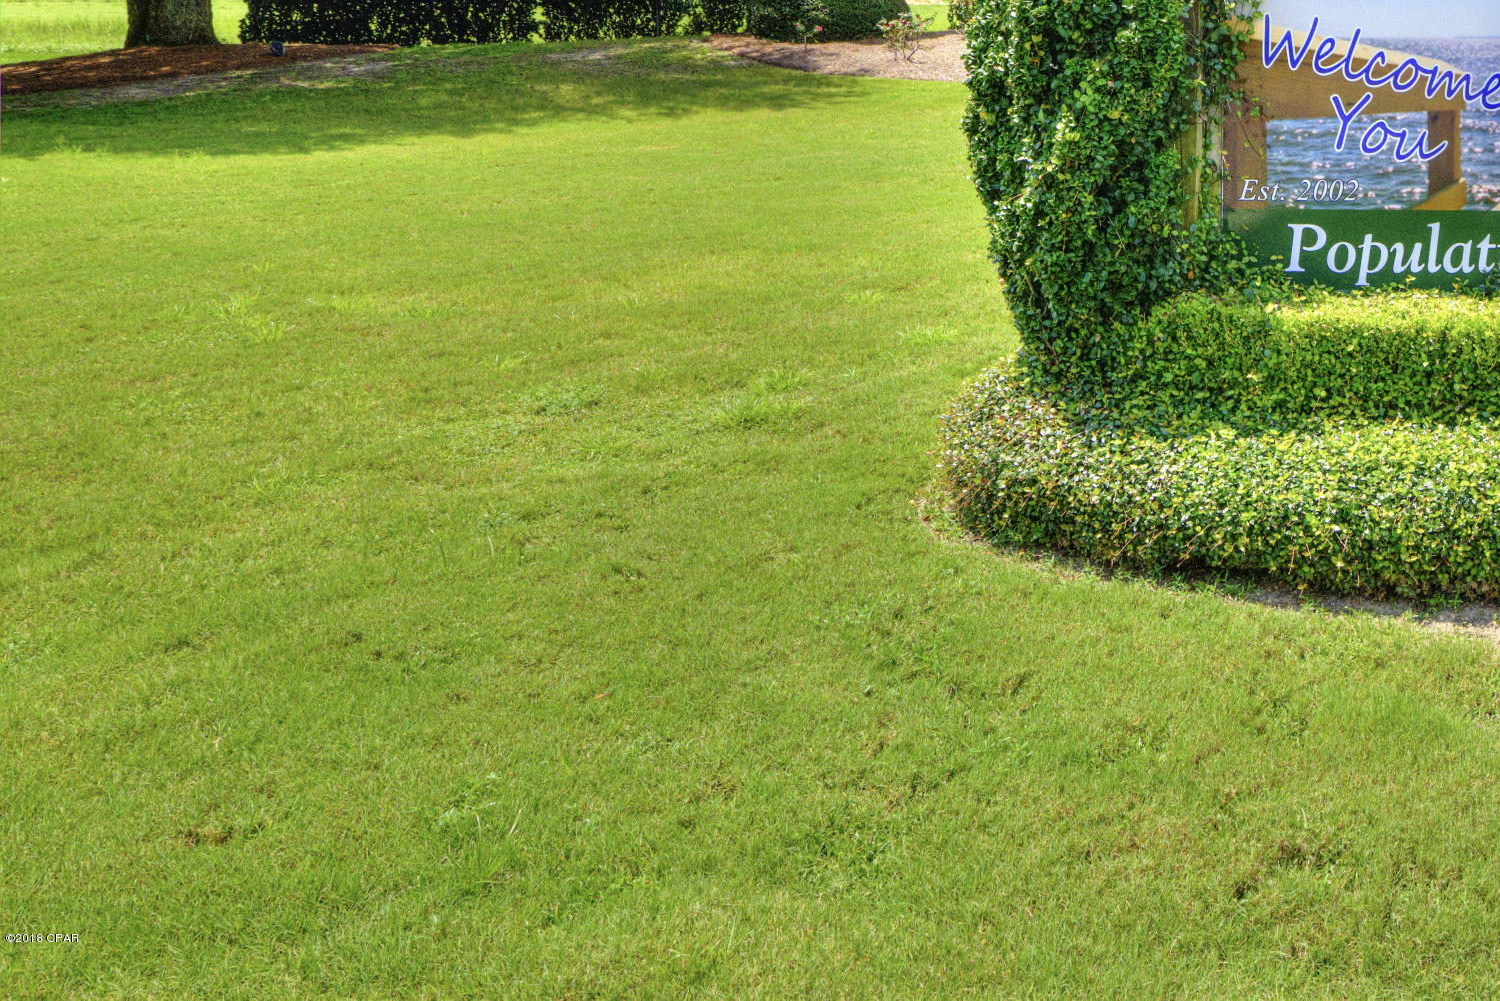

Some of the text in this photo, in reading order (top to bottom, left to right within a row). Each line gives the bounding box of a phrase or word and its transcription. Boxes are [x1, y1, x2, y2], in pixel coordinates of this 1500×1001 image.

[1330, 91, 1448, 162] You
[1238, 178, 1360, 203] Est. 2002
